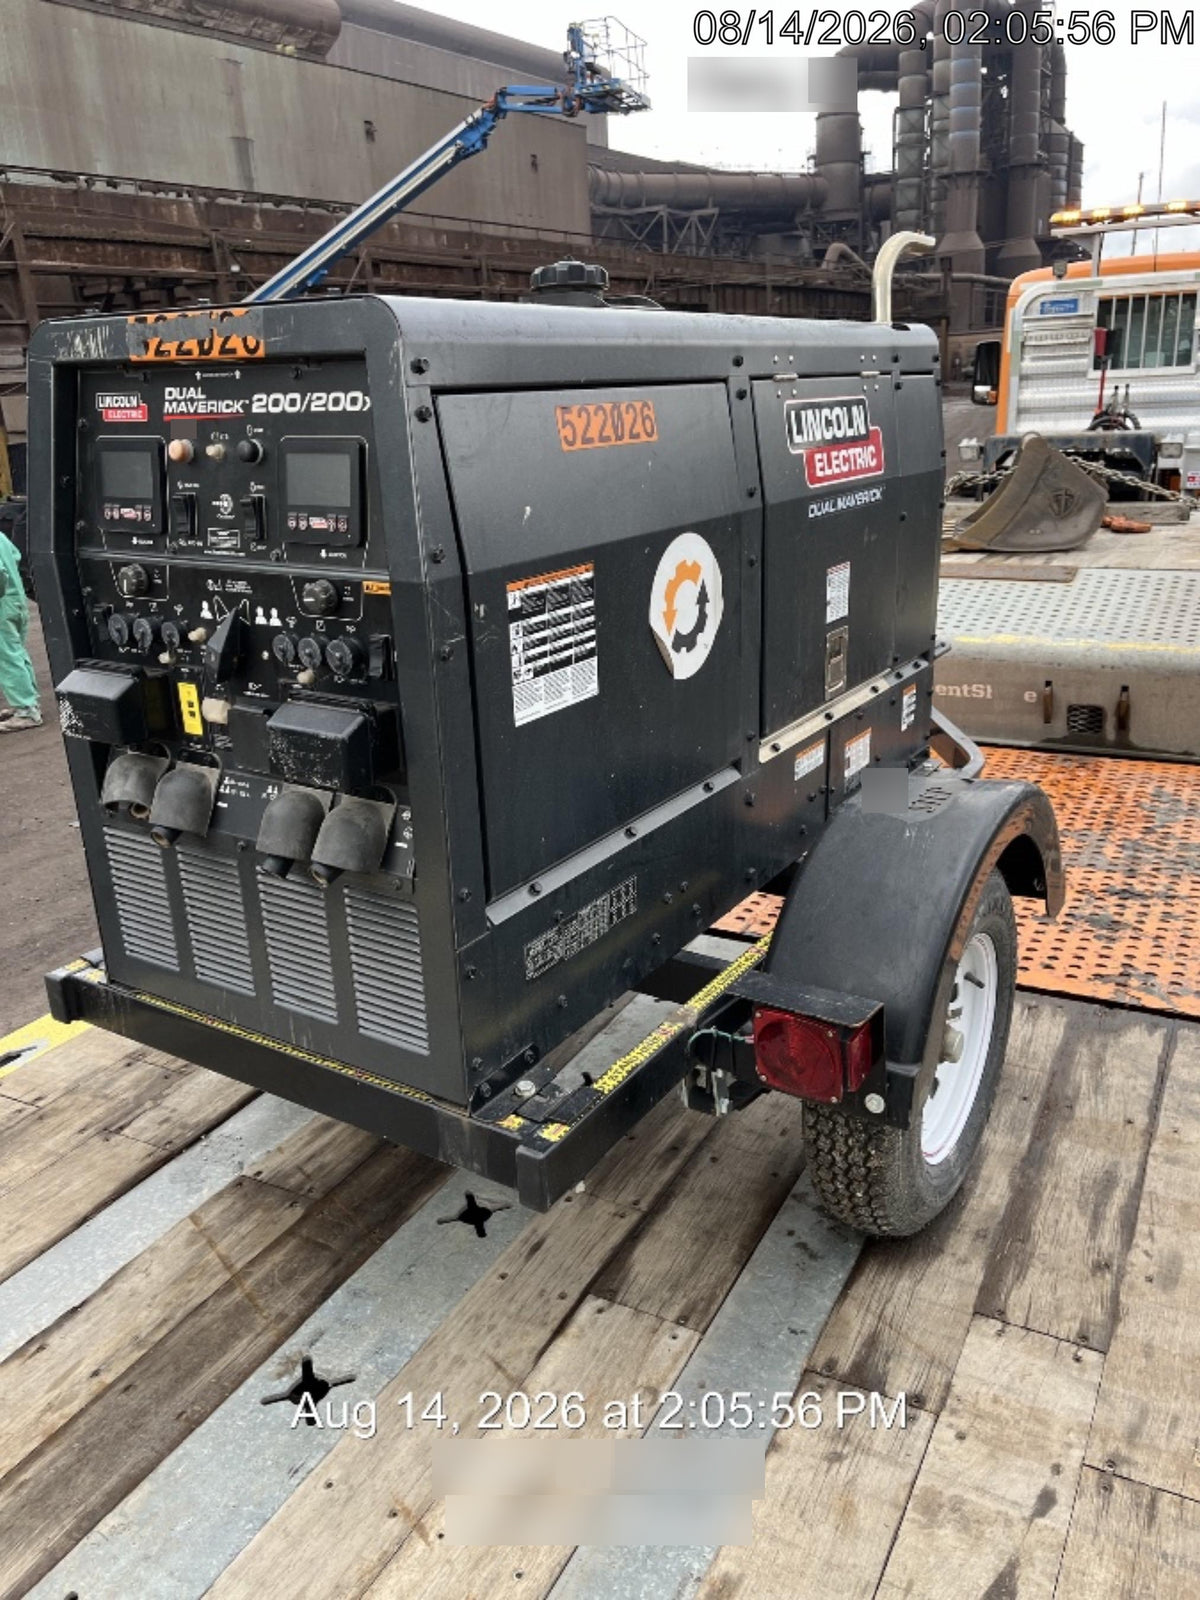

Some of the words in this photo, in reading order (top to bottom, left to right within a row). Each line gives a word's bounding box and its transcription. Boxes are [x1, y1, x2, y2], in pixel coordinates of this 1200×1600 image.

[98, 395, 138, 408] LINCOLN
[164, 386, 207, 400] DUAL
[560, 401, 656, 447] 522026
[790, 404, 867, 444] LINCOLN
[814, 445, 878, 478] ELECTRIC
[808, 500, 836, 519] DUAL
